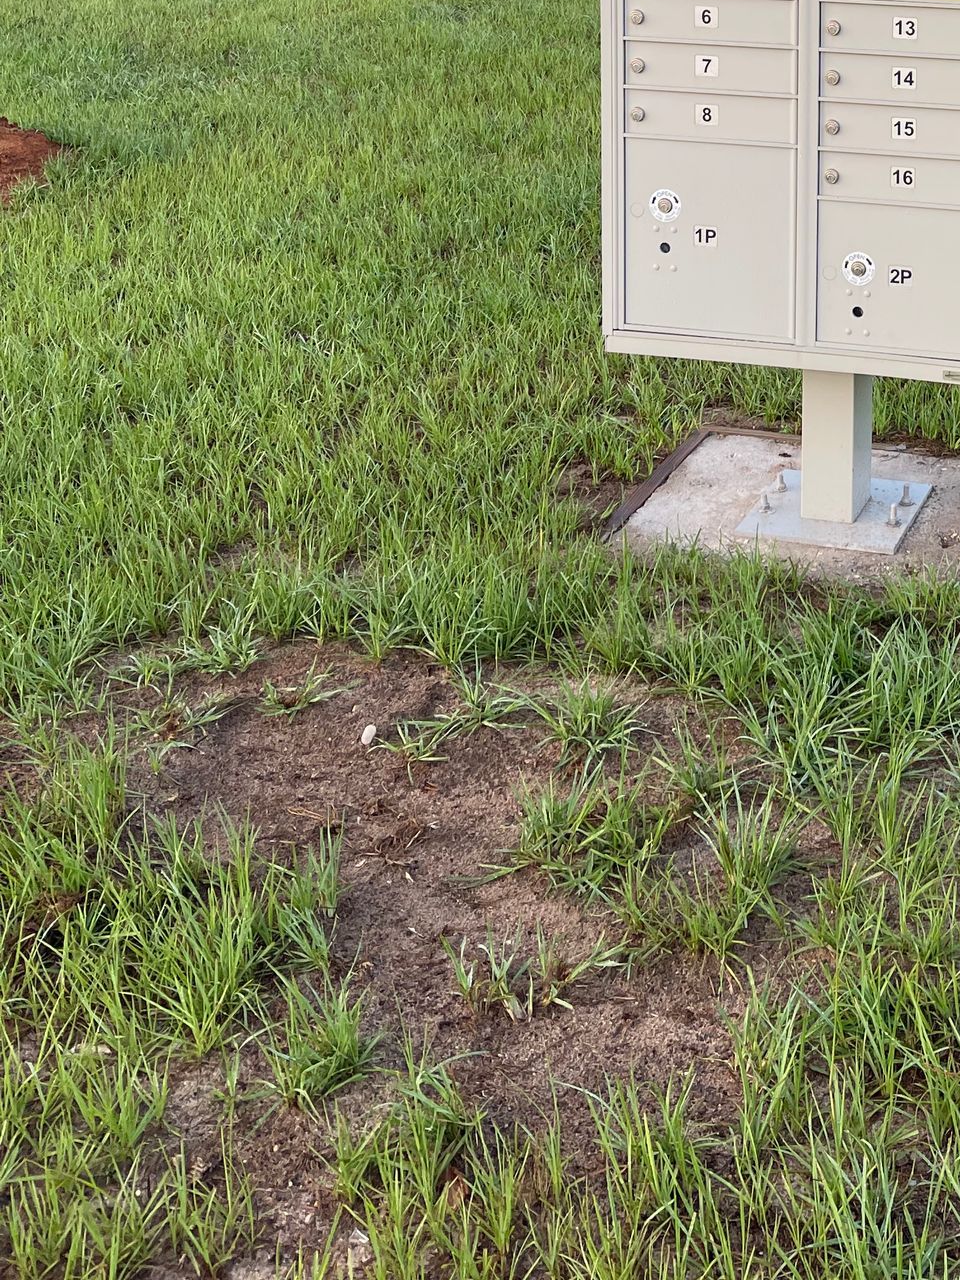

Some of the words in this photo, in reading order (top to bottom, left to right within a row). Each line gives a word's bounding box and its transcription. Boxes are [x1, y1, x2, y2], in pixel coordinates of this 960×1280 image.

[701, 10, 711, 24] 6
[895, 21, 915, 36] 13
[702, 58, 712, 72] 7
[894, 71, 914, 85] 14
[702, 107, 712, 122] 8
[893, 121, 914, 136] 15
[893, 170, 913, 185] 16
[695, 229, 717, 244] 1P
[849, 253, 865, 261] OPEN
[890, 269, 912, 284] 2P
